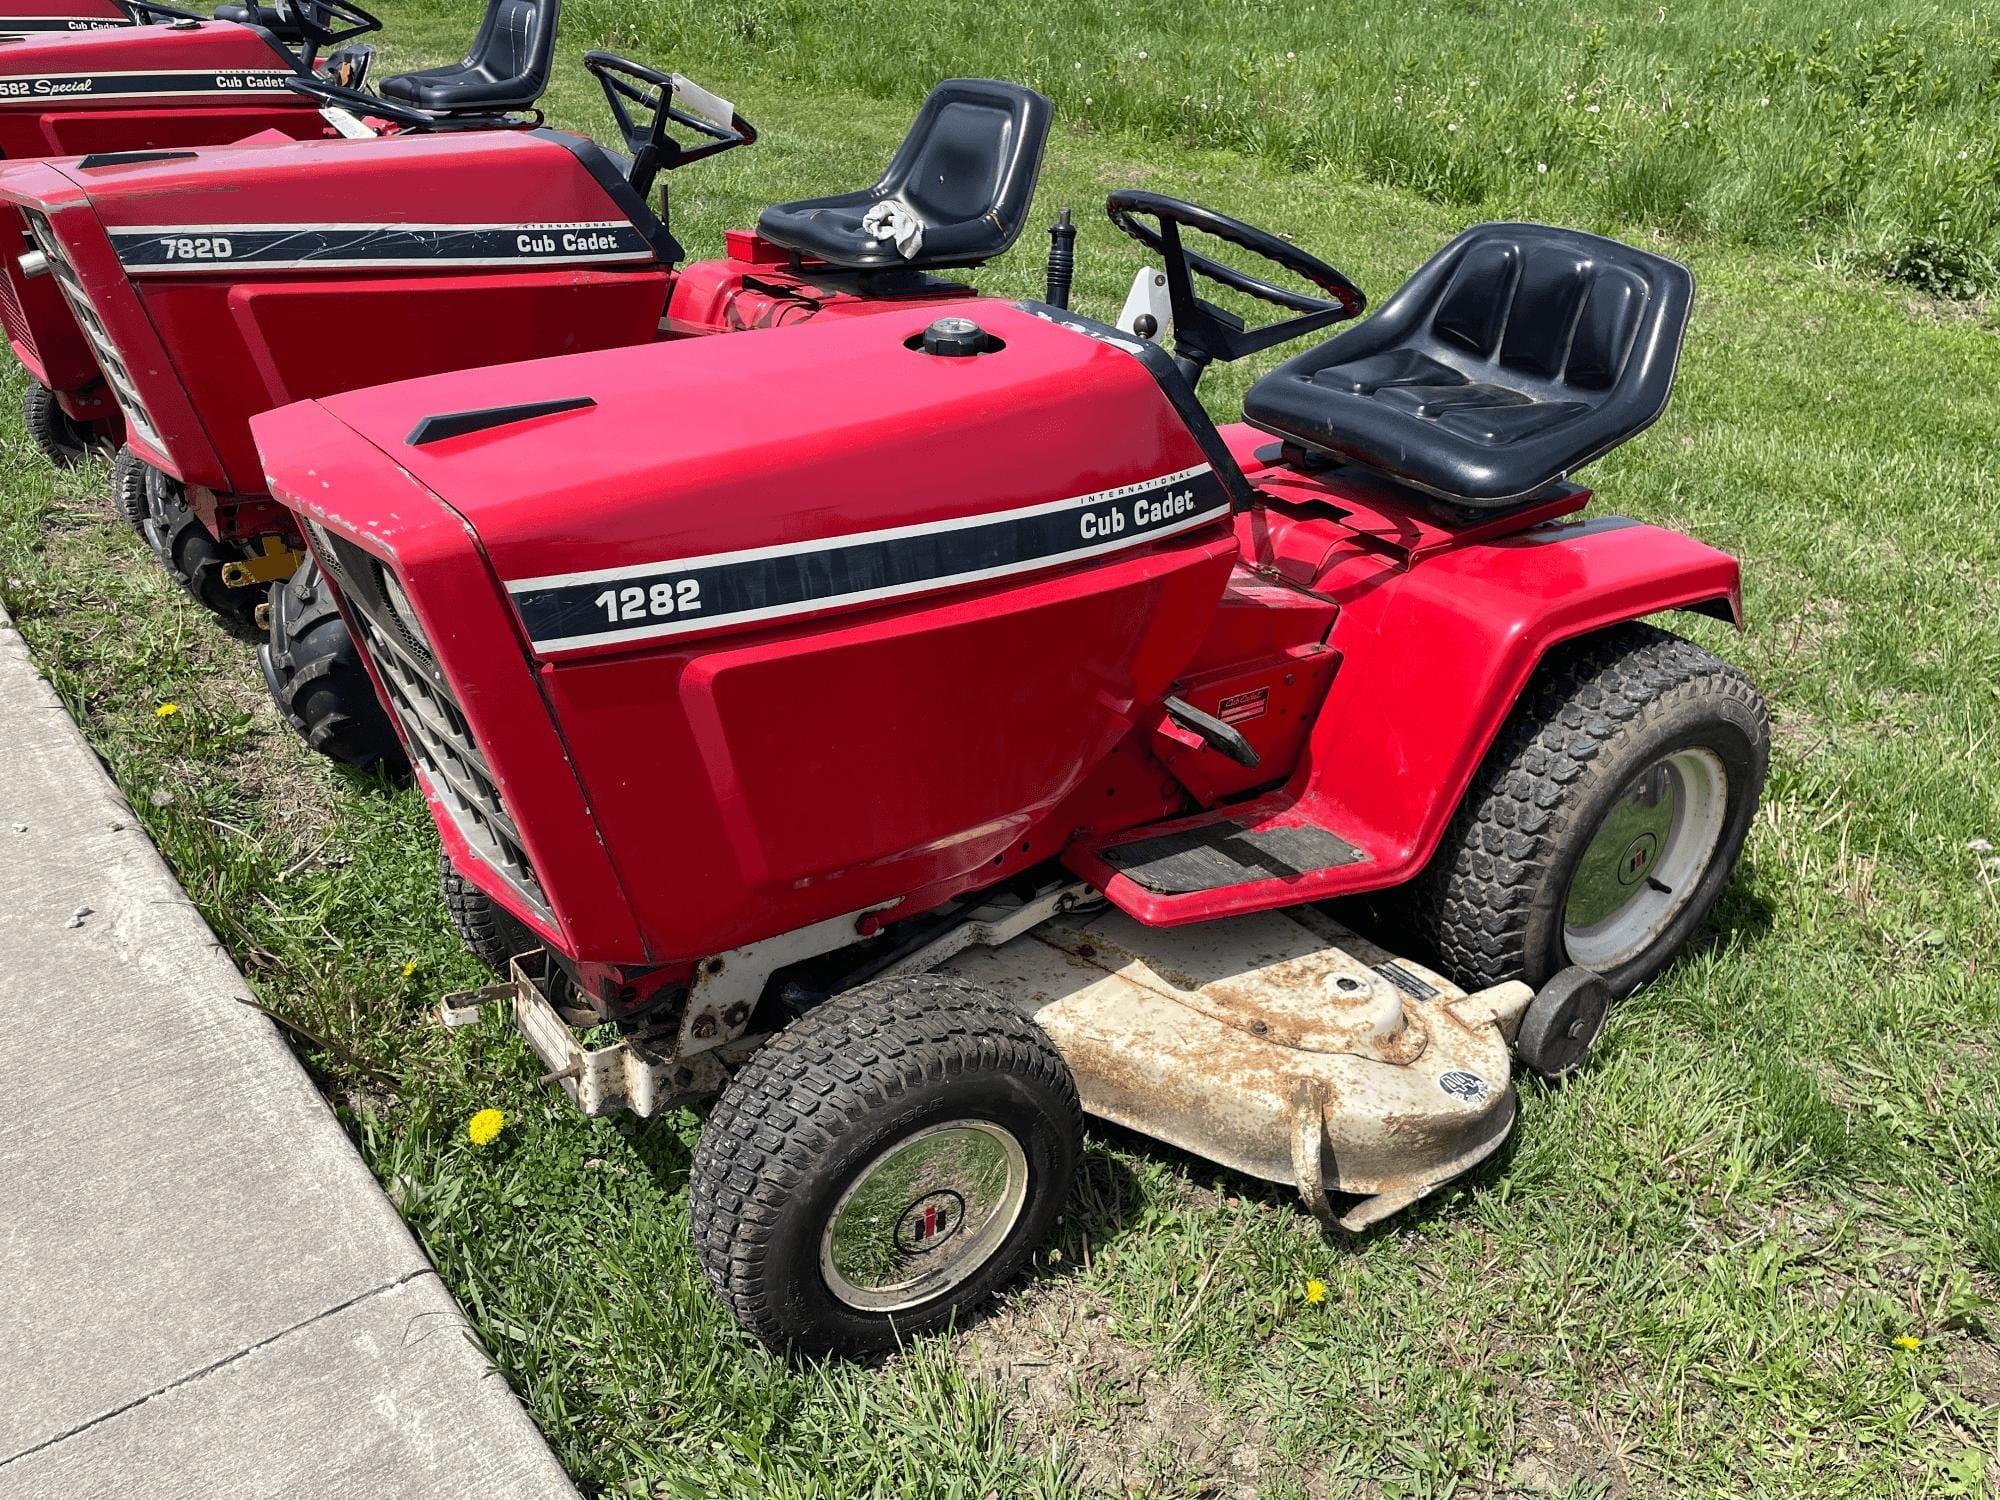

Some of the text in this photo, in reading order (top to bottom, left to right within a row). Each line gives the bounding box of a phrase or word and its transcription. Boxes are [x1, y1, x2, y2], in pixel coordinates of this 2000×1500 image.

[68, 21, 88, 30] Cub
[0, 76, 285, 96] 582 Special Cub Cadet
[160, 232, 618, 260] 782D Cub Cadet
[1081, 471, 1192, 504] INTERNATIONAL
[594, 490, 1194, 623] 1282 Cub Cadet
